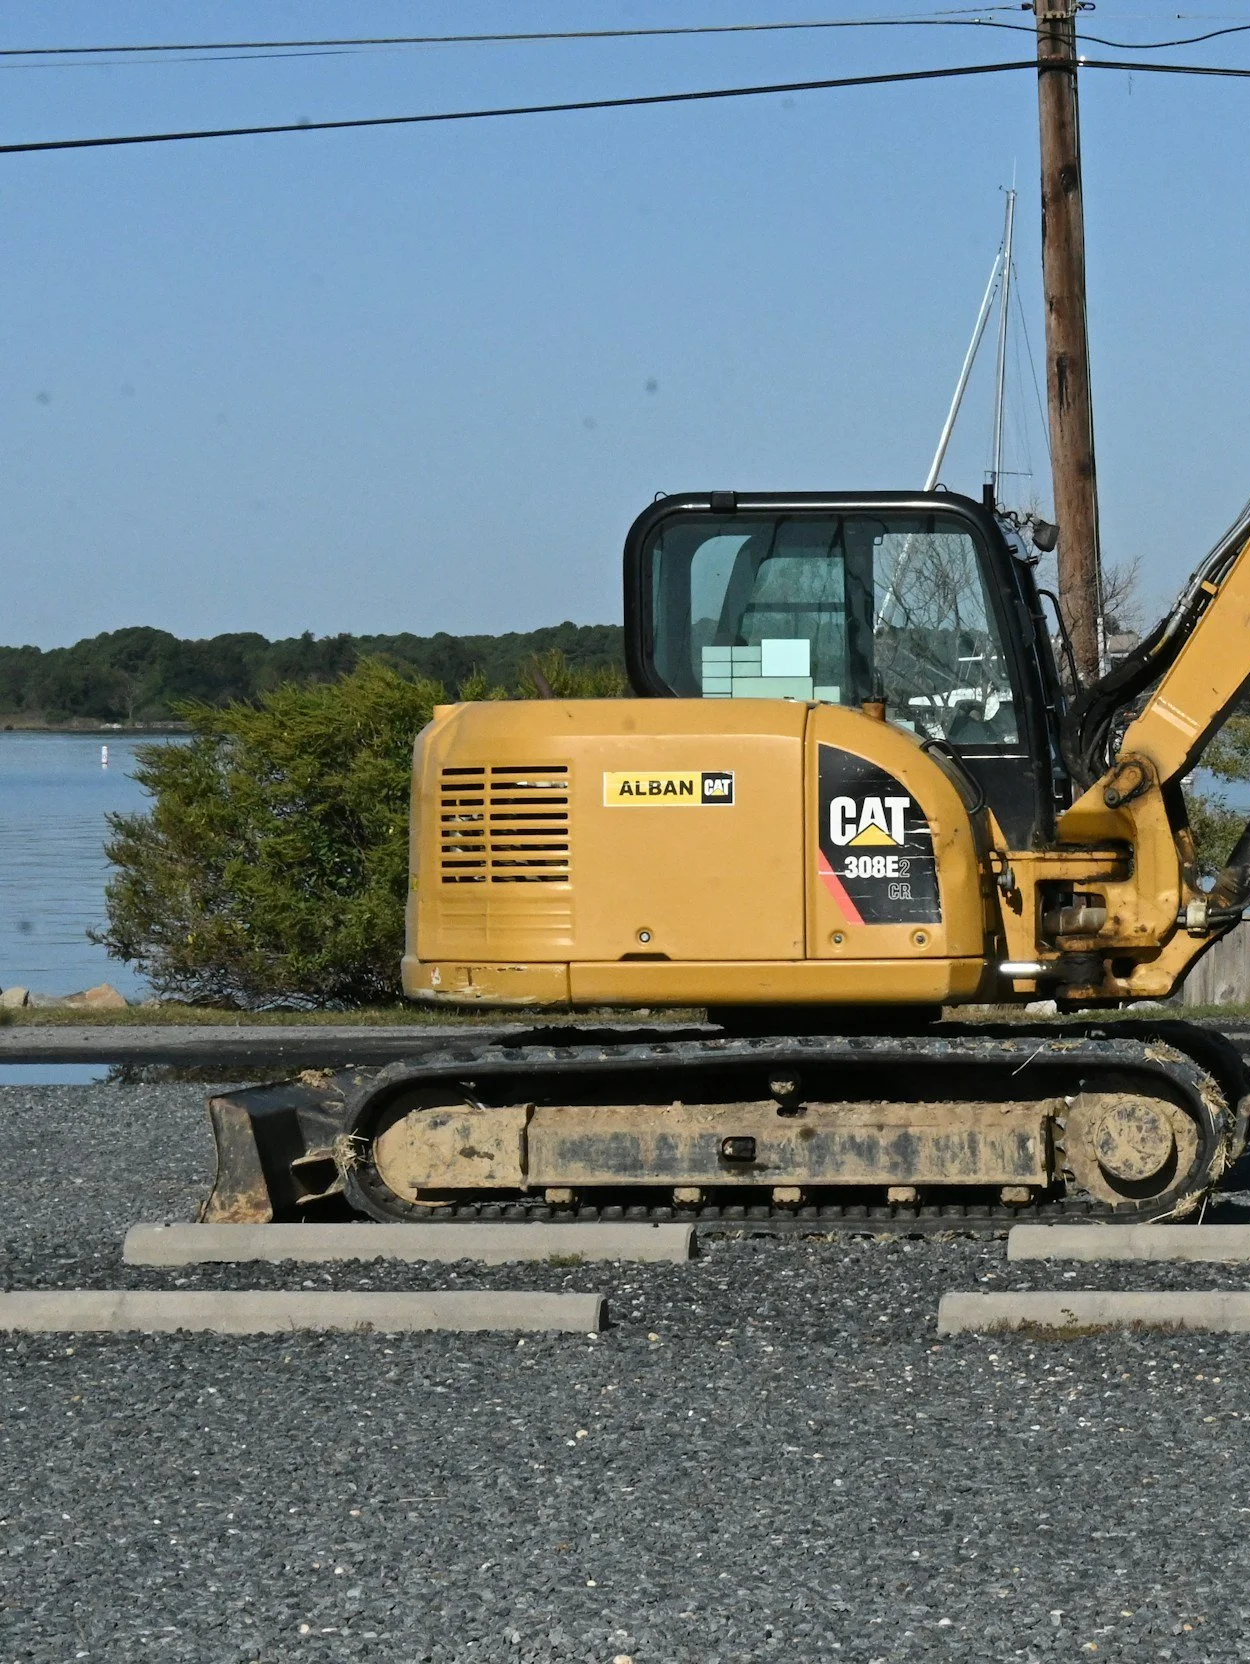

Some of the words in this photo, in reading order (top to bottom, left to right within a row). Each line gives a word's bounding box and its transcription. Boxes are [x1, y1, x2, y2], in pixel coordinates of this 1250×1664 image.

[619, 780, 693, 796] ALBAN
[703, 779, 731, 796] CAT
[830, 796, 910, 846] CAT
[888, 882, 912, 900] CR
